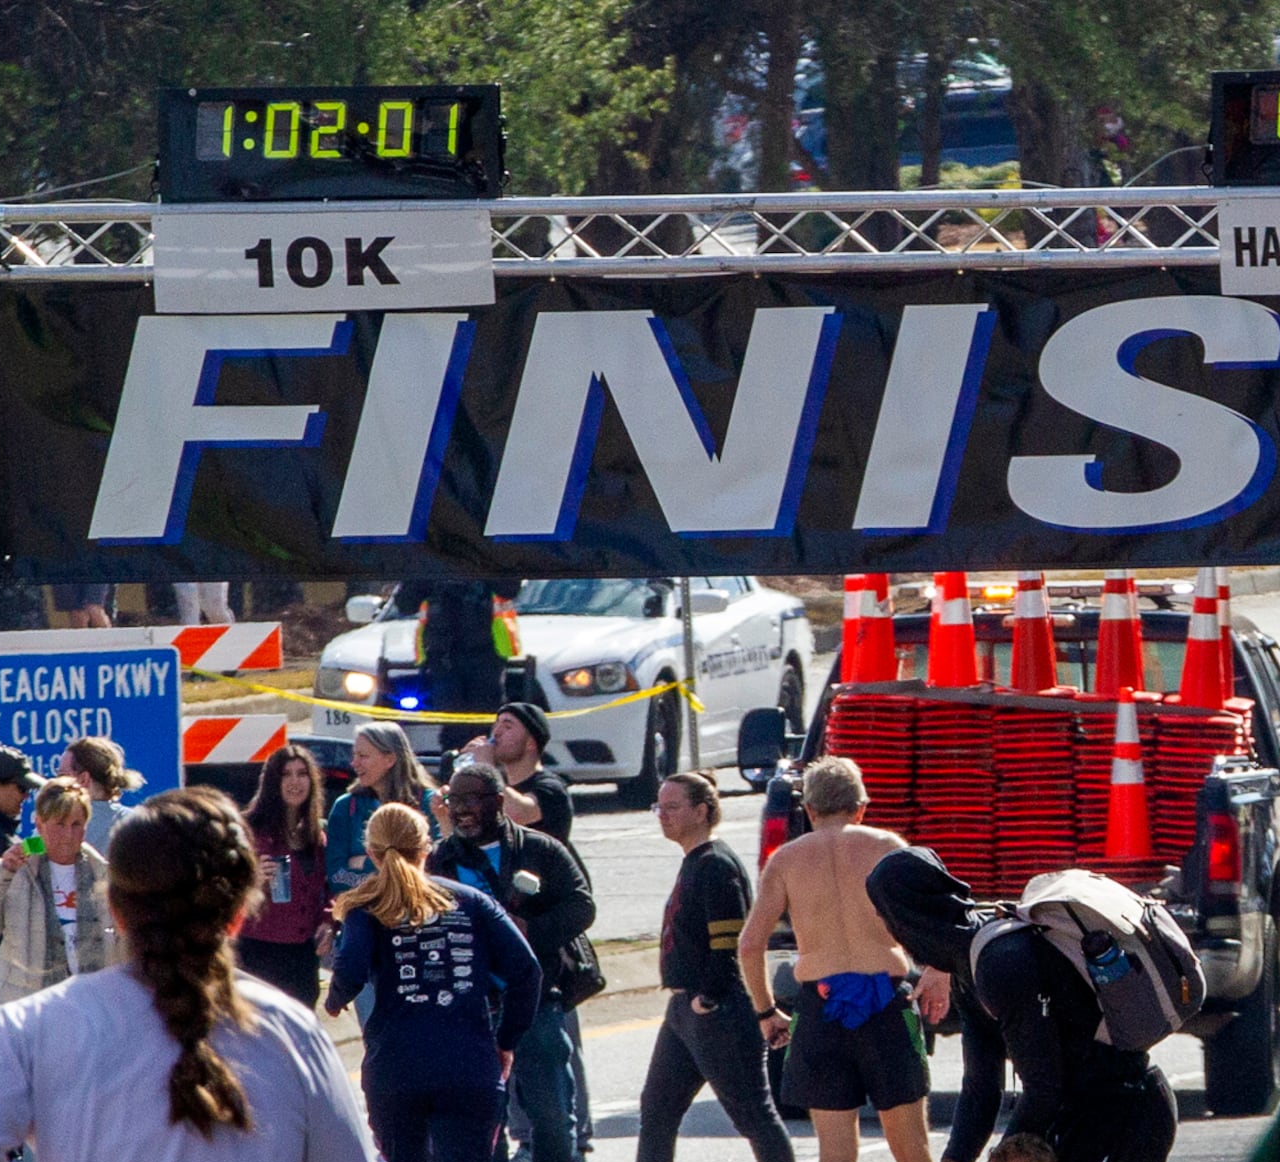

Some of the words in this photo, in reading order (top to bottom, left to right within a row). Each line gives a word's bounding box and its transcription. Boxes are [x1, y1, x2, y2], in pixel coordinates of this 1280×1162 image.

[245, 235, 401, 288] 10K
[98, 659, 170, 699] PKWY
[12, 707, 113, 745] CLOSED
[325, 708, 351, 725] 186
